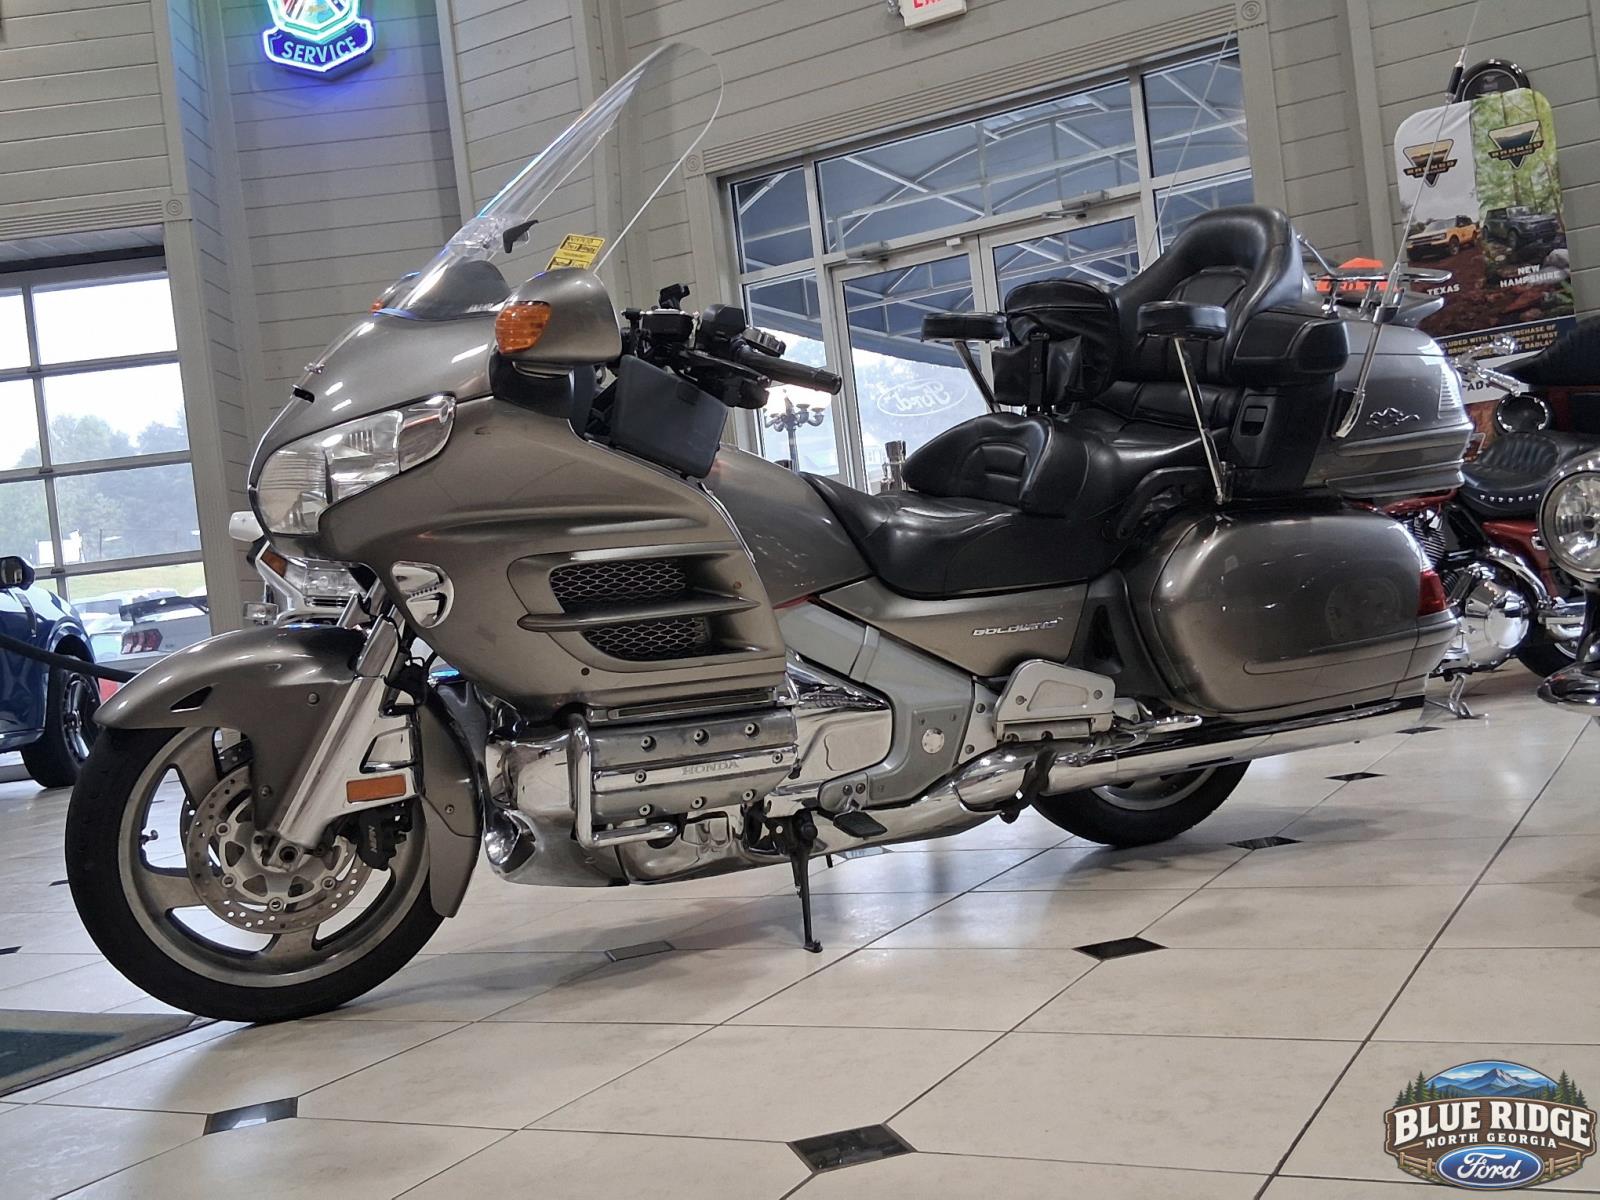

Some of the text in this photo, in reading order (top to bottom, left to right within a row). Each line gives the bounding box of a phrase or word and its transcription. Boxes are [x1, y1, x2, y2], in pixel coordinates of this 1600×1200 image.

[281, 36, 357, 63] SERVICE
[1517, 264, 1540, 275] NEW
[1499, 270, 1561, 288] HAMPSHIRE
[1427, 284, 1460, 296] TEXAS
[1469, 335, 1489, 344] WITH
[1536, 331, 1558, 340] FIRST
[681, 760, 740, 775] HONDA
